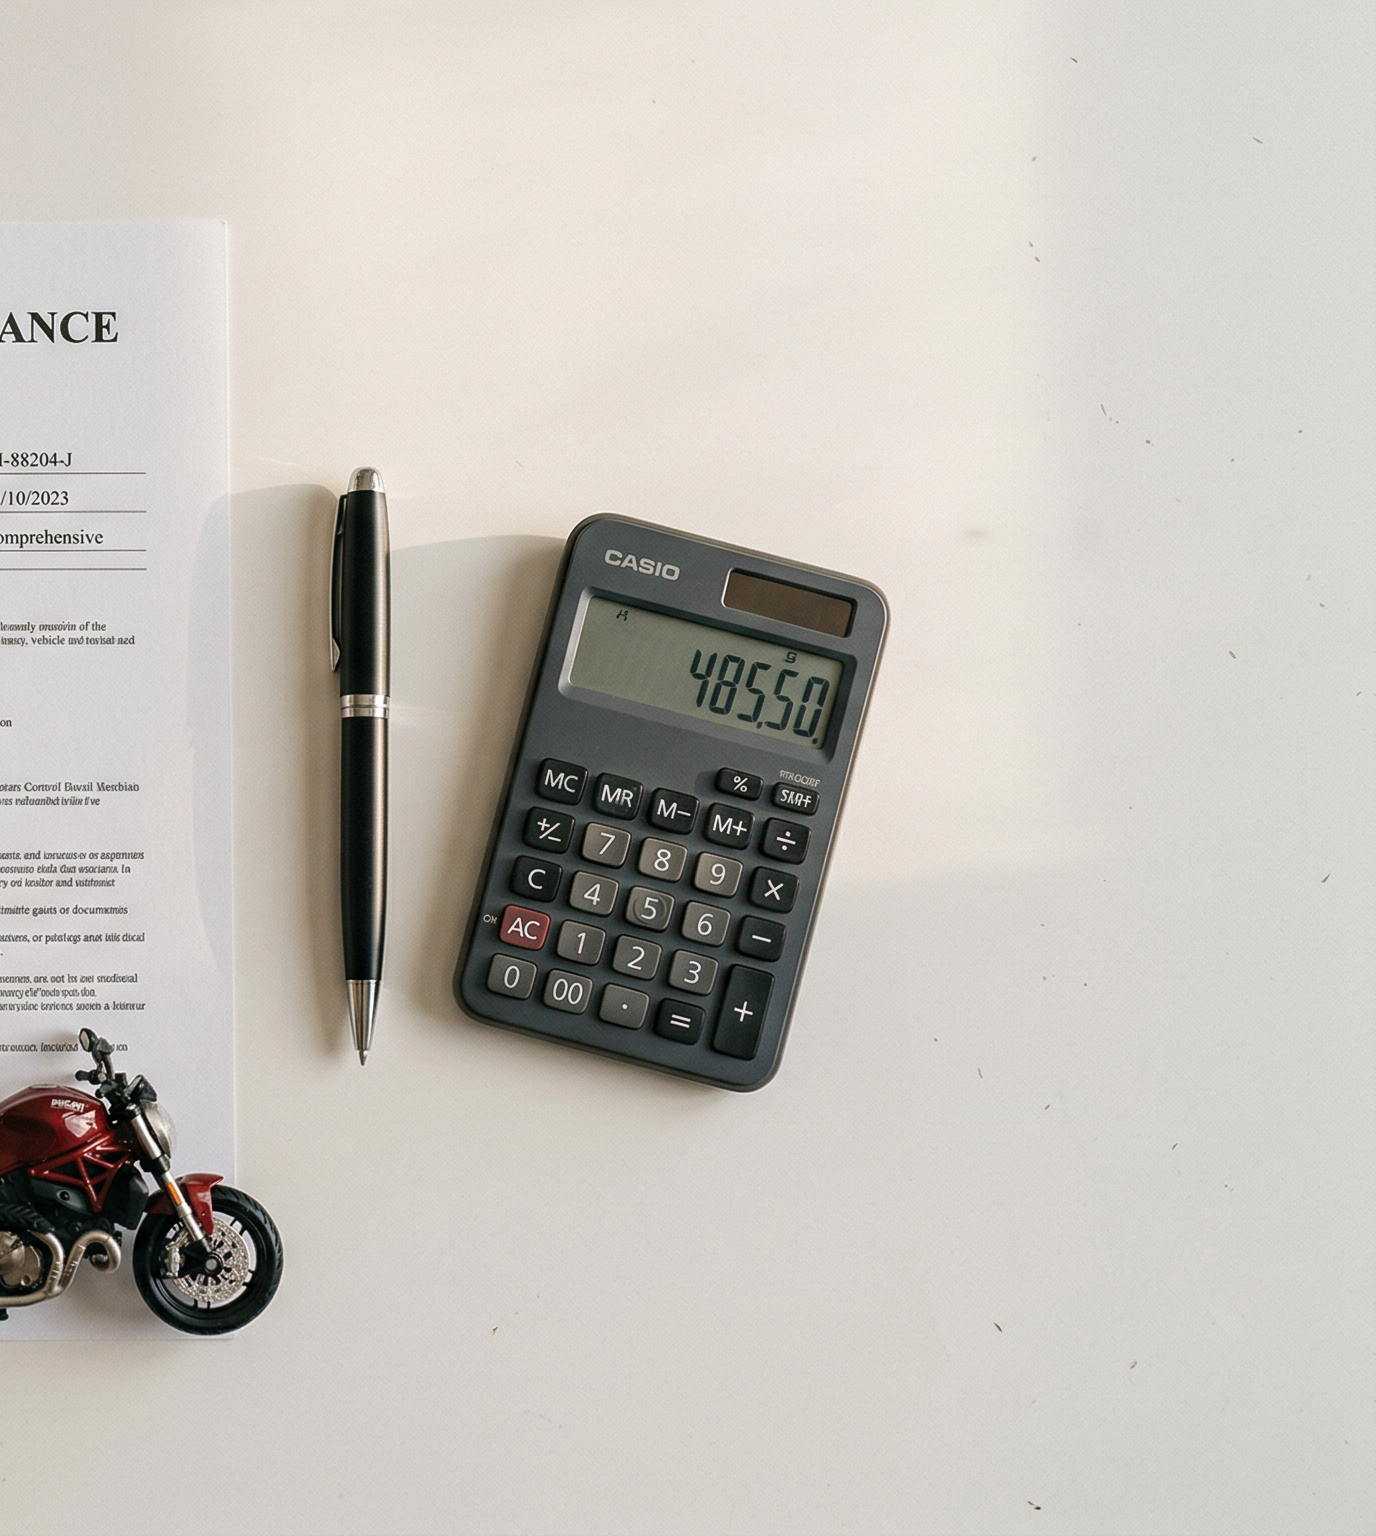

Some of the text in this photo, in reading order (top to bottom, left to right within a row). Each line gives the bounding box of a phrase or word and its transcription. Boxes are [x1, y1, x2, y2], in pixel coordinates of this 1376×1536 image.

[605, 549, 680, 581] CASIO
[79, 621, 90, 631] of
[92, 621, 106, 631] the
[544, 769, 578, 792] MC
[733, 775, 748, 792] %
[601, 784, 634, 808] MR
[713, 814, 747, 836] M+
[599, 832, 615, 855] 7
[655, 849, 670, 872] 8
[528, 868, 546, 890] C
[711, 863, 725, 886] 9
[592, 884, 607, 906] 4
[643, 898, 659, 920] 5
[507, 920, 540, 941] AC
[697, 913, 713, 936] 6
[576, 932, 585, 954] 1
[627, 946, 645, 970] 2
[505, 966, 520, 989] 0
[684, 960, 702, 984] 3
[552, 979, 583, 1005] 00
